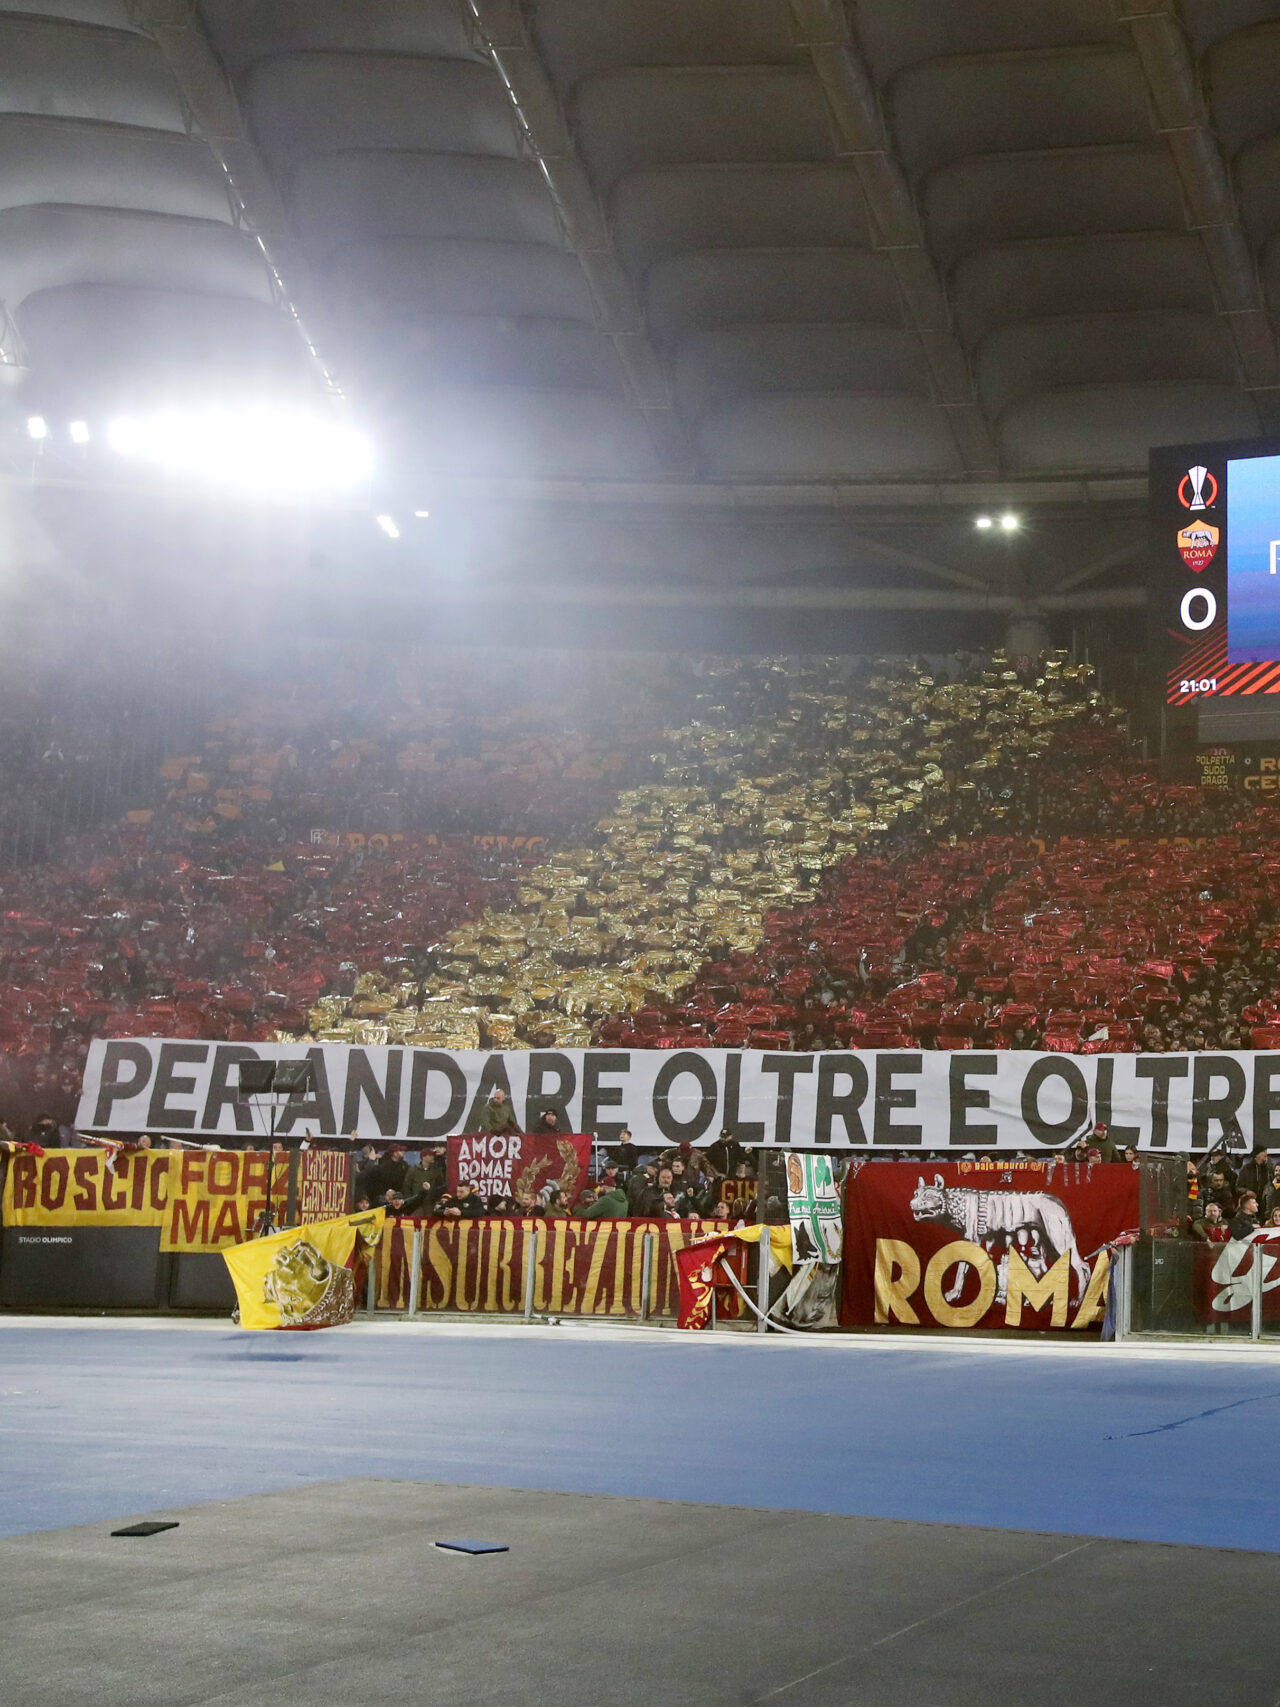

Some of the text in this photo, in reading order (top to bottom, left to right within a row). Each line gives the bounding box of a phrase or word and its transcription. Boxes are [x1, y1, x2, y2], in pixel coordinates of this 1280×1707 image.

[1183, 549, 1213, 560] ROMA
[1180, 587, 1217, 631] 0
[1180, 678, 1218, 694] 21:01
[1196, 755, 1236, 766] POLPETTA
[1200, 775, 1229, 785] DRAGO
[93, 1041, 261, 1132] PER
[273, 1047, 632, 1144] ANDARE
[652, 1051, 923, 1146] OLTRE
[948, 1053, 999, 1146] E
[458, 1136, 522, 1161] AMOR
[458, 1160, 513, 1181] ROMAE
[469, 1179, 513, 1197] OSTRA
[18, 1236, 73, 1244] STADIO OLIMPICO
[874, 1238, 1111, 1329] ROMA
